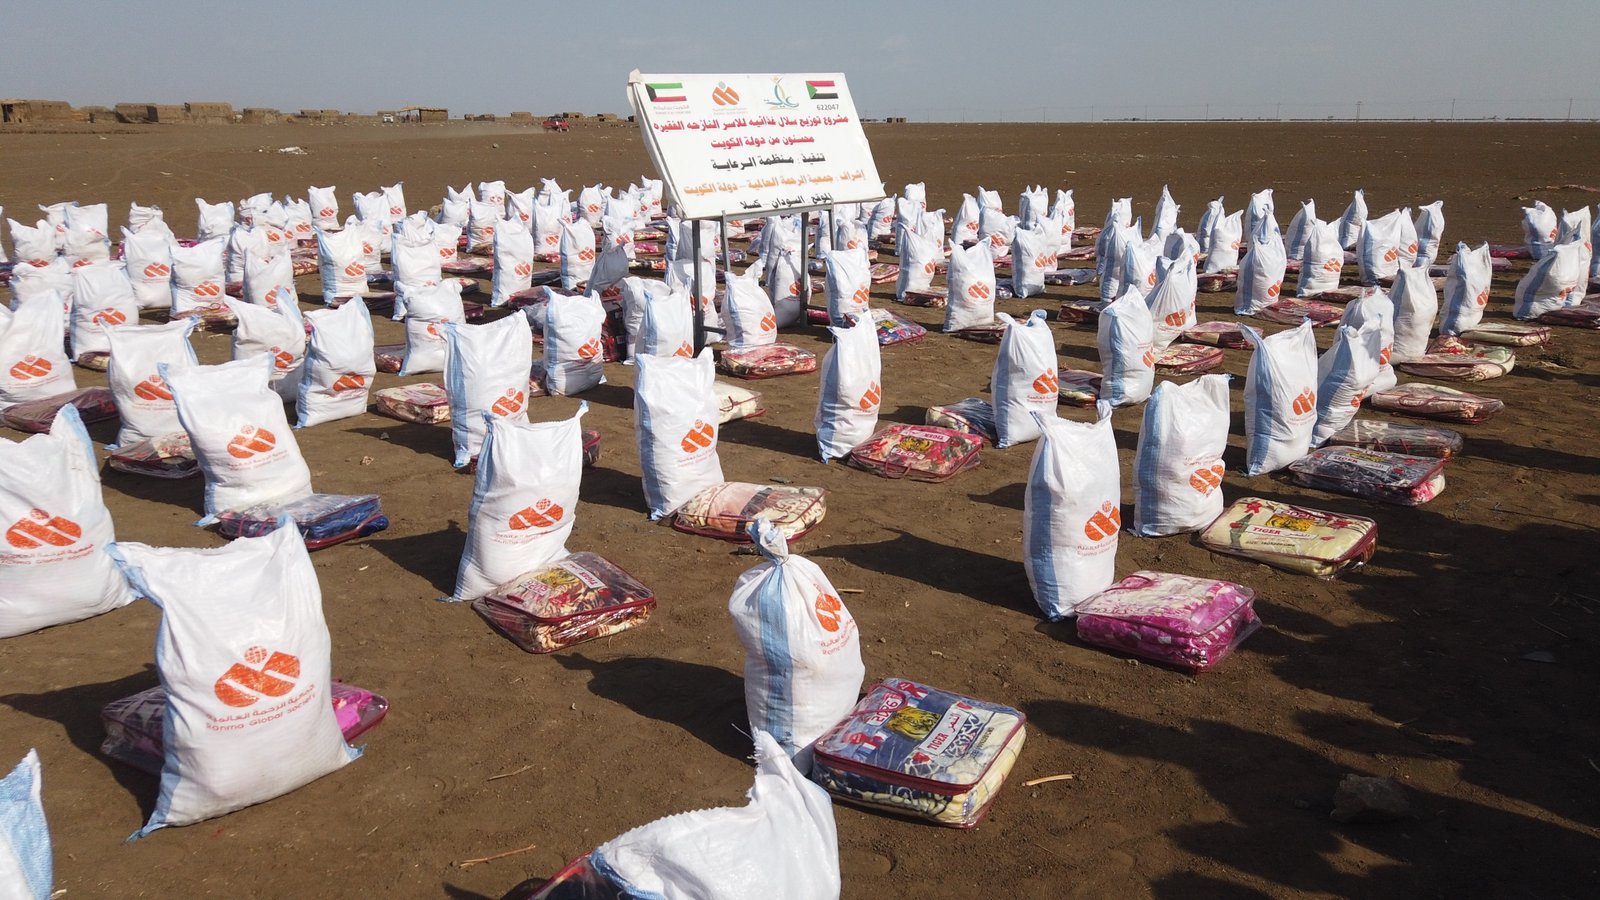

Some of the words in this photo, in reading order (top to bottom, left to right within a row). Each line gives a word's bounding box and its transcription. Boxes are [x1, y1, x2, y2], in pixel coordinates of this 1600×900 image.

[816, 103, 839, 111] 622047
[778, 117, 798, 127] سلال
[800, 116, 822, 127] توزيع
[823, 114, 849, 126] مشروع
[711, 137, 744, 150] الكويت
[745, 136, 766, 147] دولة
[769, 136, 780, 145] من
[783, 134, 815, 145] محسنون
[757, 153, 794, 166] منظمة
[746, 176, 779, 191] العالمية
[780, 174, 807, 186] الرحمة
[807, 174, 833, 185] جمعية
[683, 183, 717, 196] الكويت
[716, 182, 738, 193] دولة
[772, 195, 806, 208] السودان
[1253, 527, 1281, 535] TIGER
[927, 732, 949, 751] TIGER
